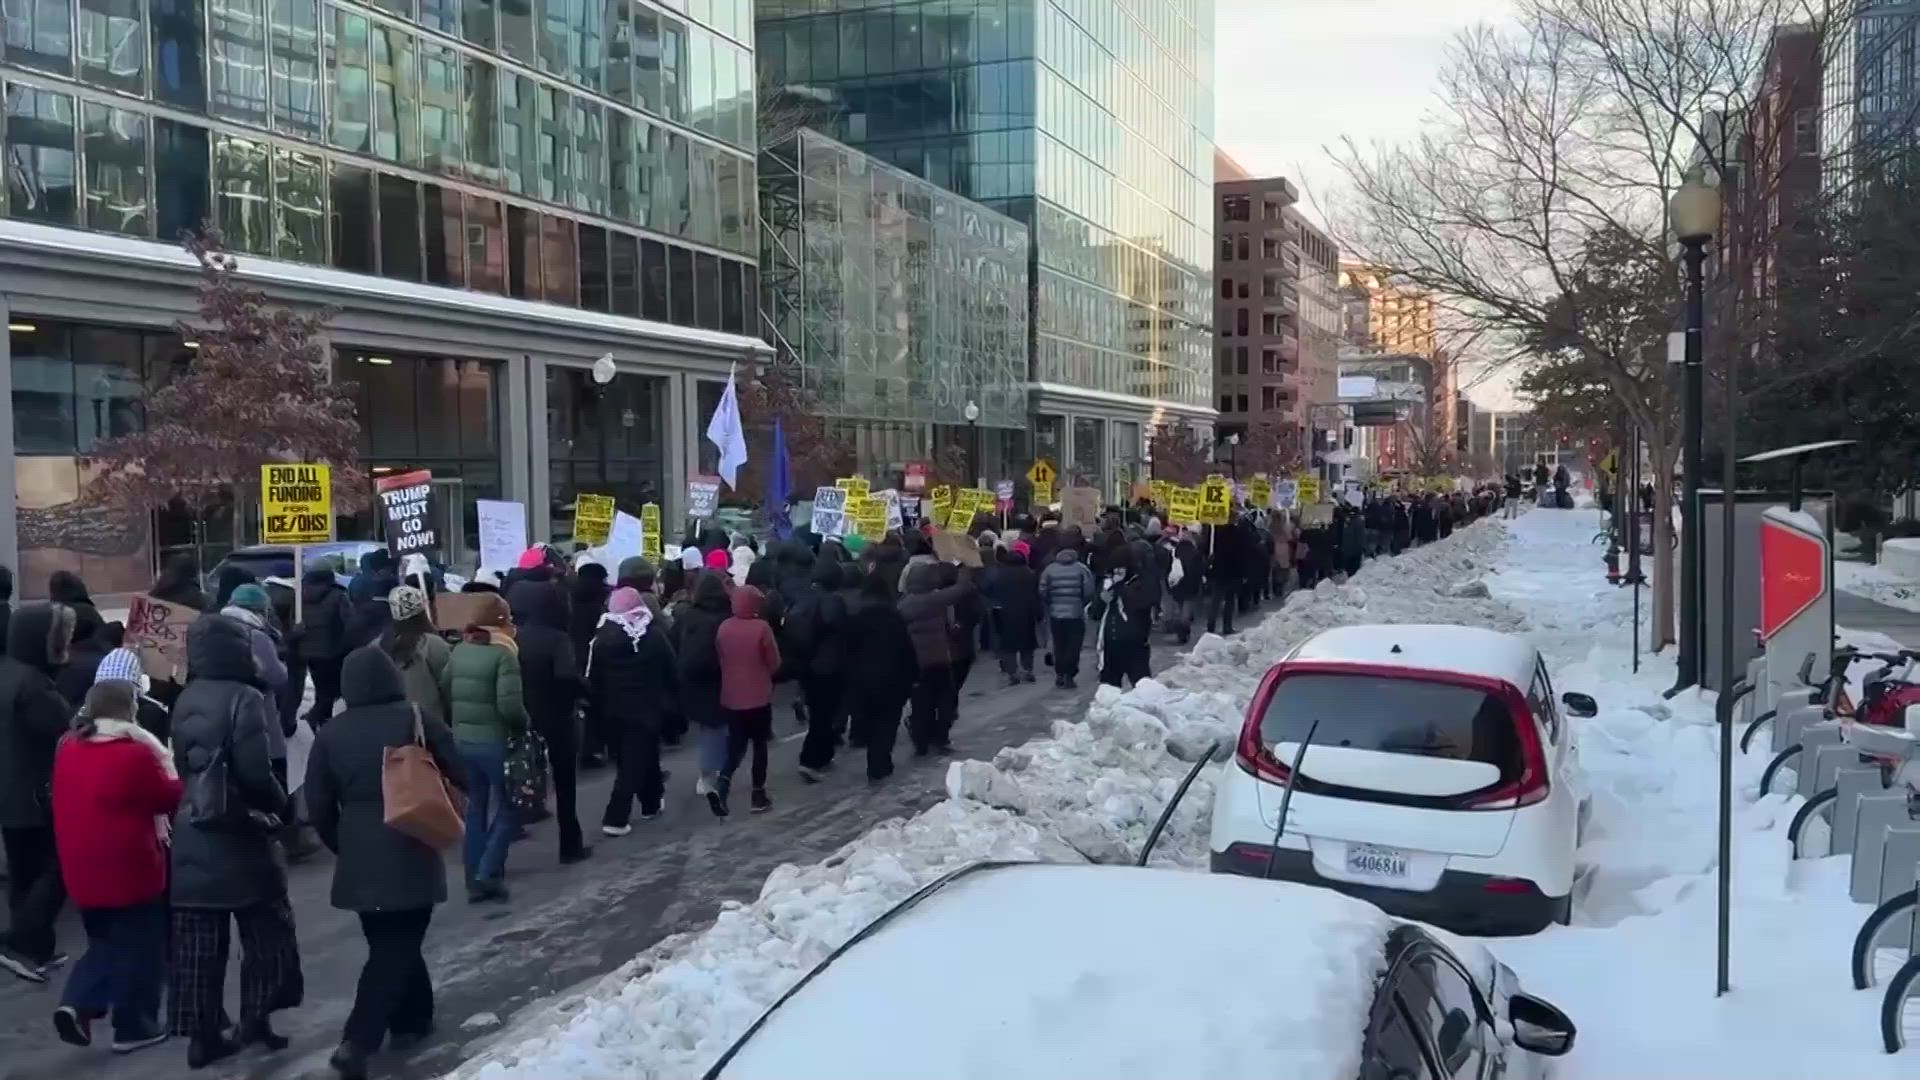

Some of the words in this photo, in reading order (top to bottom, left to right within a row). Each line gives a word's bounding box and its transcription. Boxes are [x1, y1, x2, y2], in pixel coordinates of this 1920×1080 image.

[270, 467, 295, 485] END
[298, 467, 320, 484] ALL
[269, 486, 322, 502] FUNDING
[380, 484, 430, 505] TRUMP
[388, 500, 428, 521] MUST
[267, 513, 328, 533] ICE/DHS!
[402, 518, 422, 533] GO
[397, 530, 434, 551] NOW!
